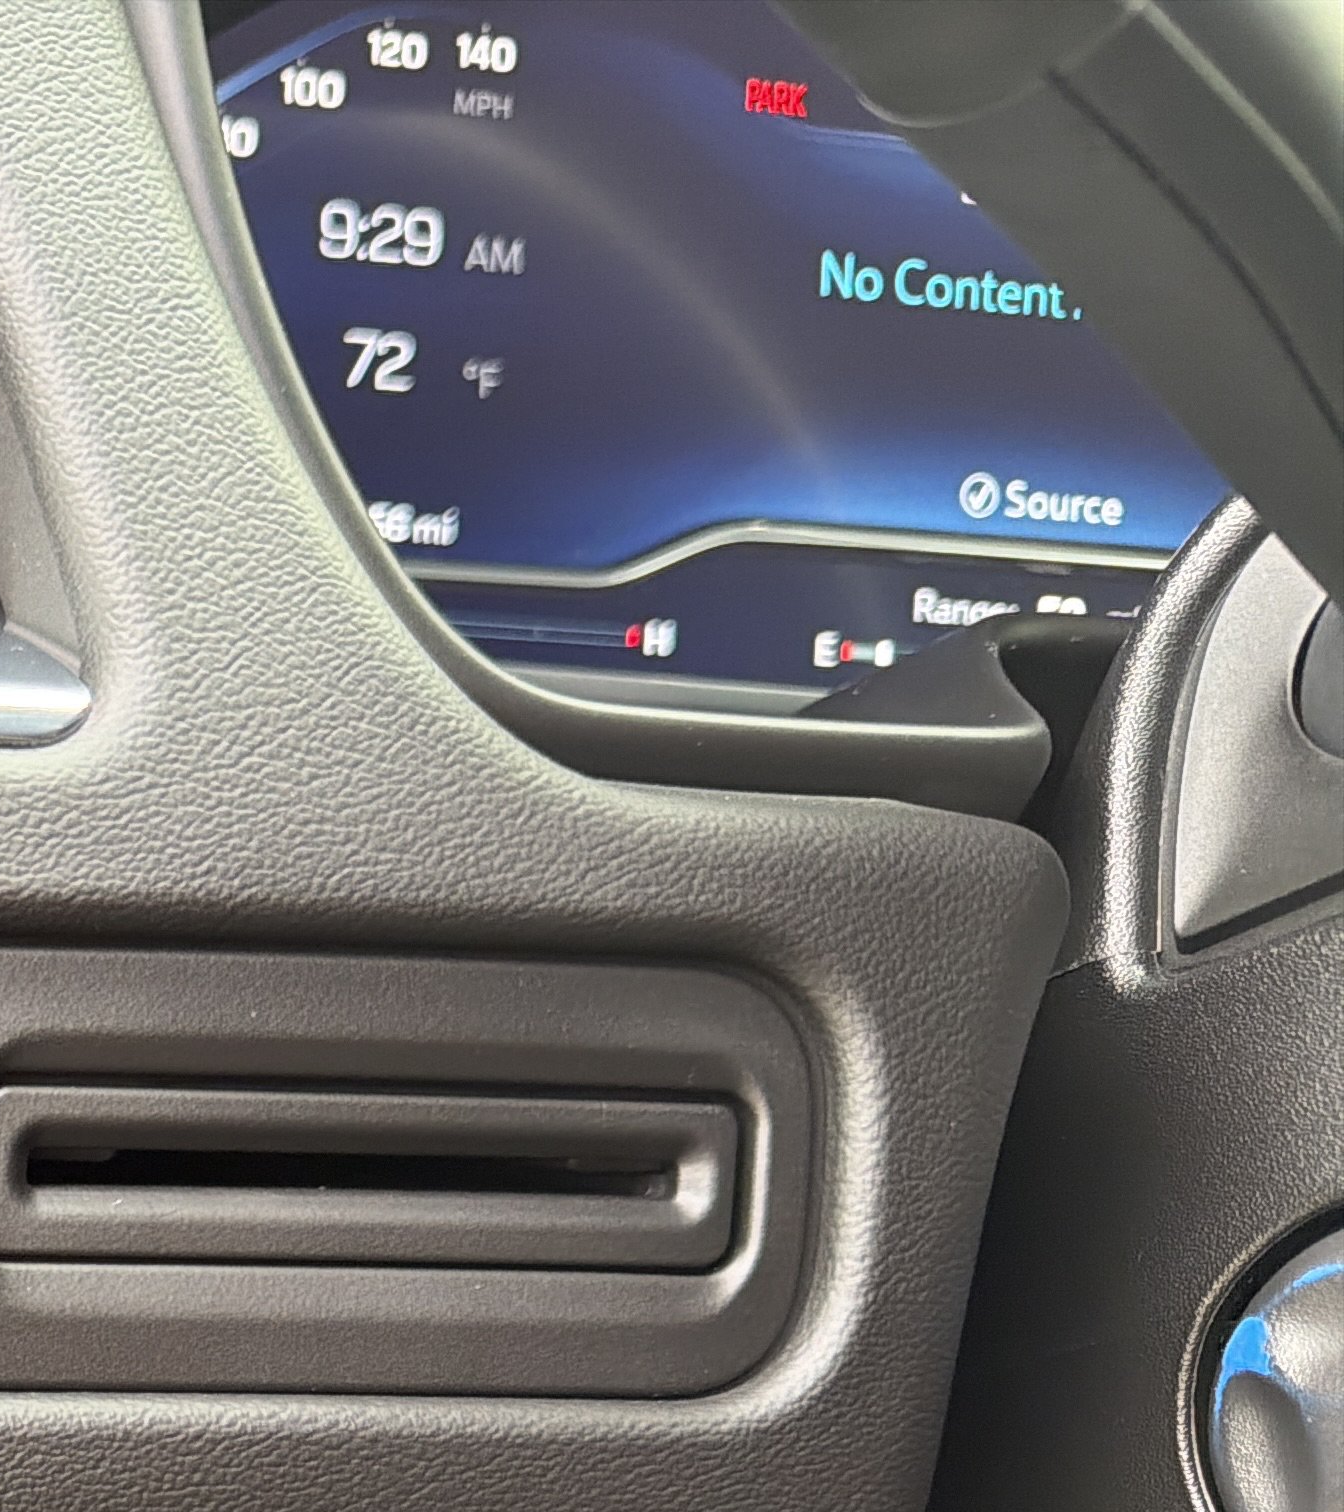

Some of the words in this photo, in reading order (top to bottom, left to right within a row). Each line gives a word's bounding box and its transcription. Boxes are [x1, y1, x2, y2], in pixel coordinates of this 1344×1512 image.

[368, 28, 428, 70] 120
[456, 32, 517, 73] 140
[280, 66, 345, 108] 100
[453, 89, 513, 119] MPH
[744, 77, 808, 118] PARK
[319, 198, 445, 267] 9:29
[464, 235, 525, 275] AM
[820, 249, 884, 302] No
[343, 327, 417, 392] 72
[1004, 480, 1124, 527] Source
[412, 506, 460, 547] mi
[643, 618, 677, 657] H
[813, 630, 842, 668] E
